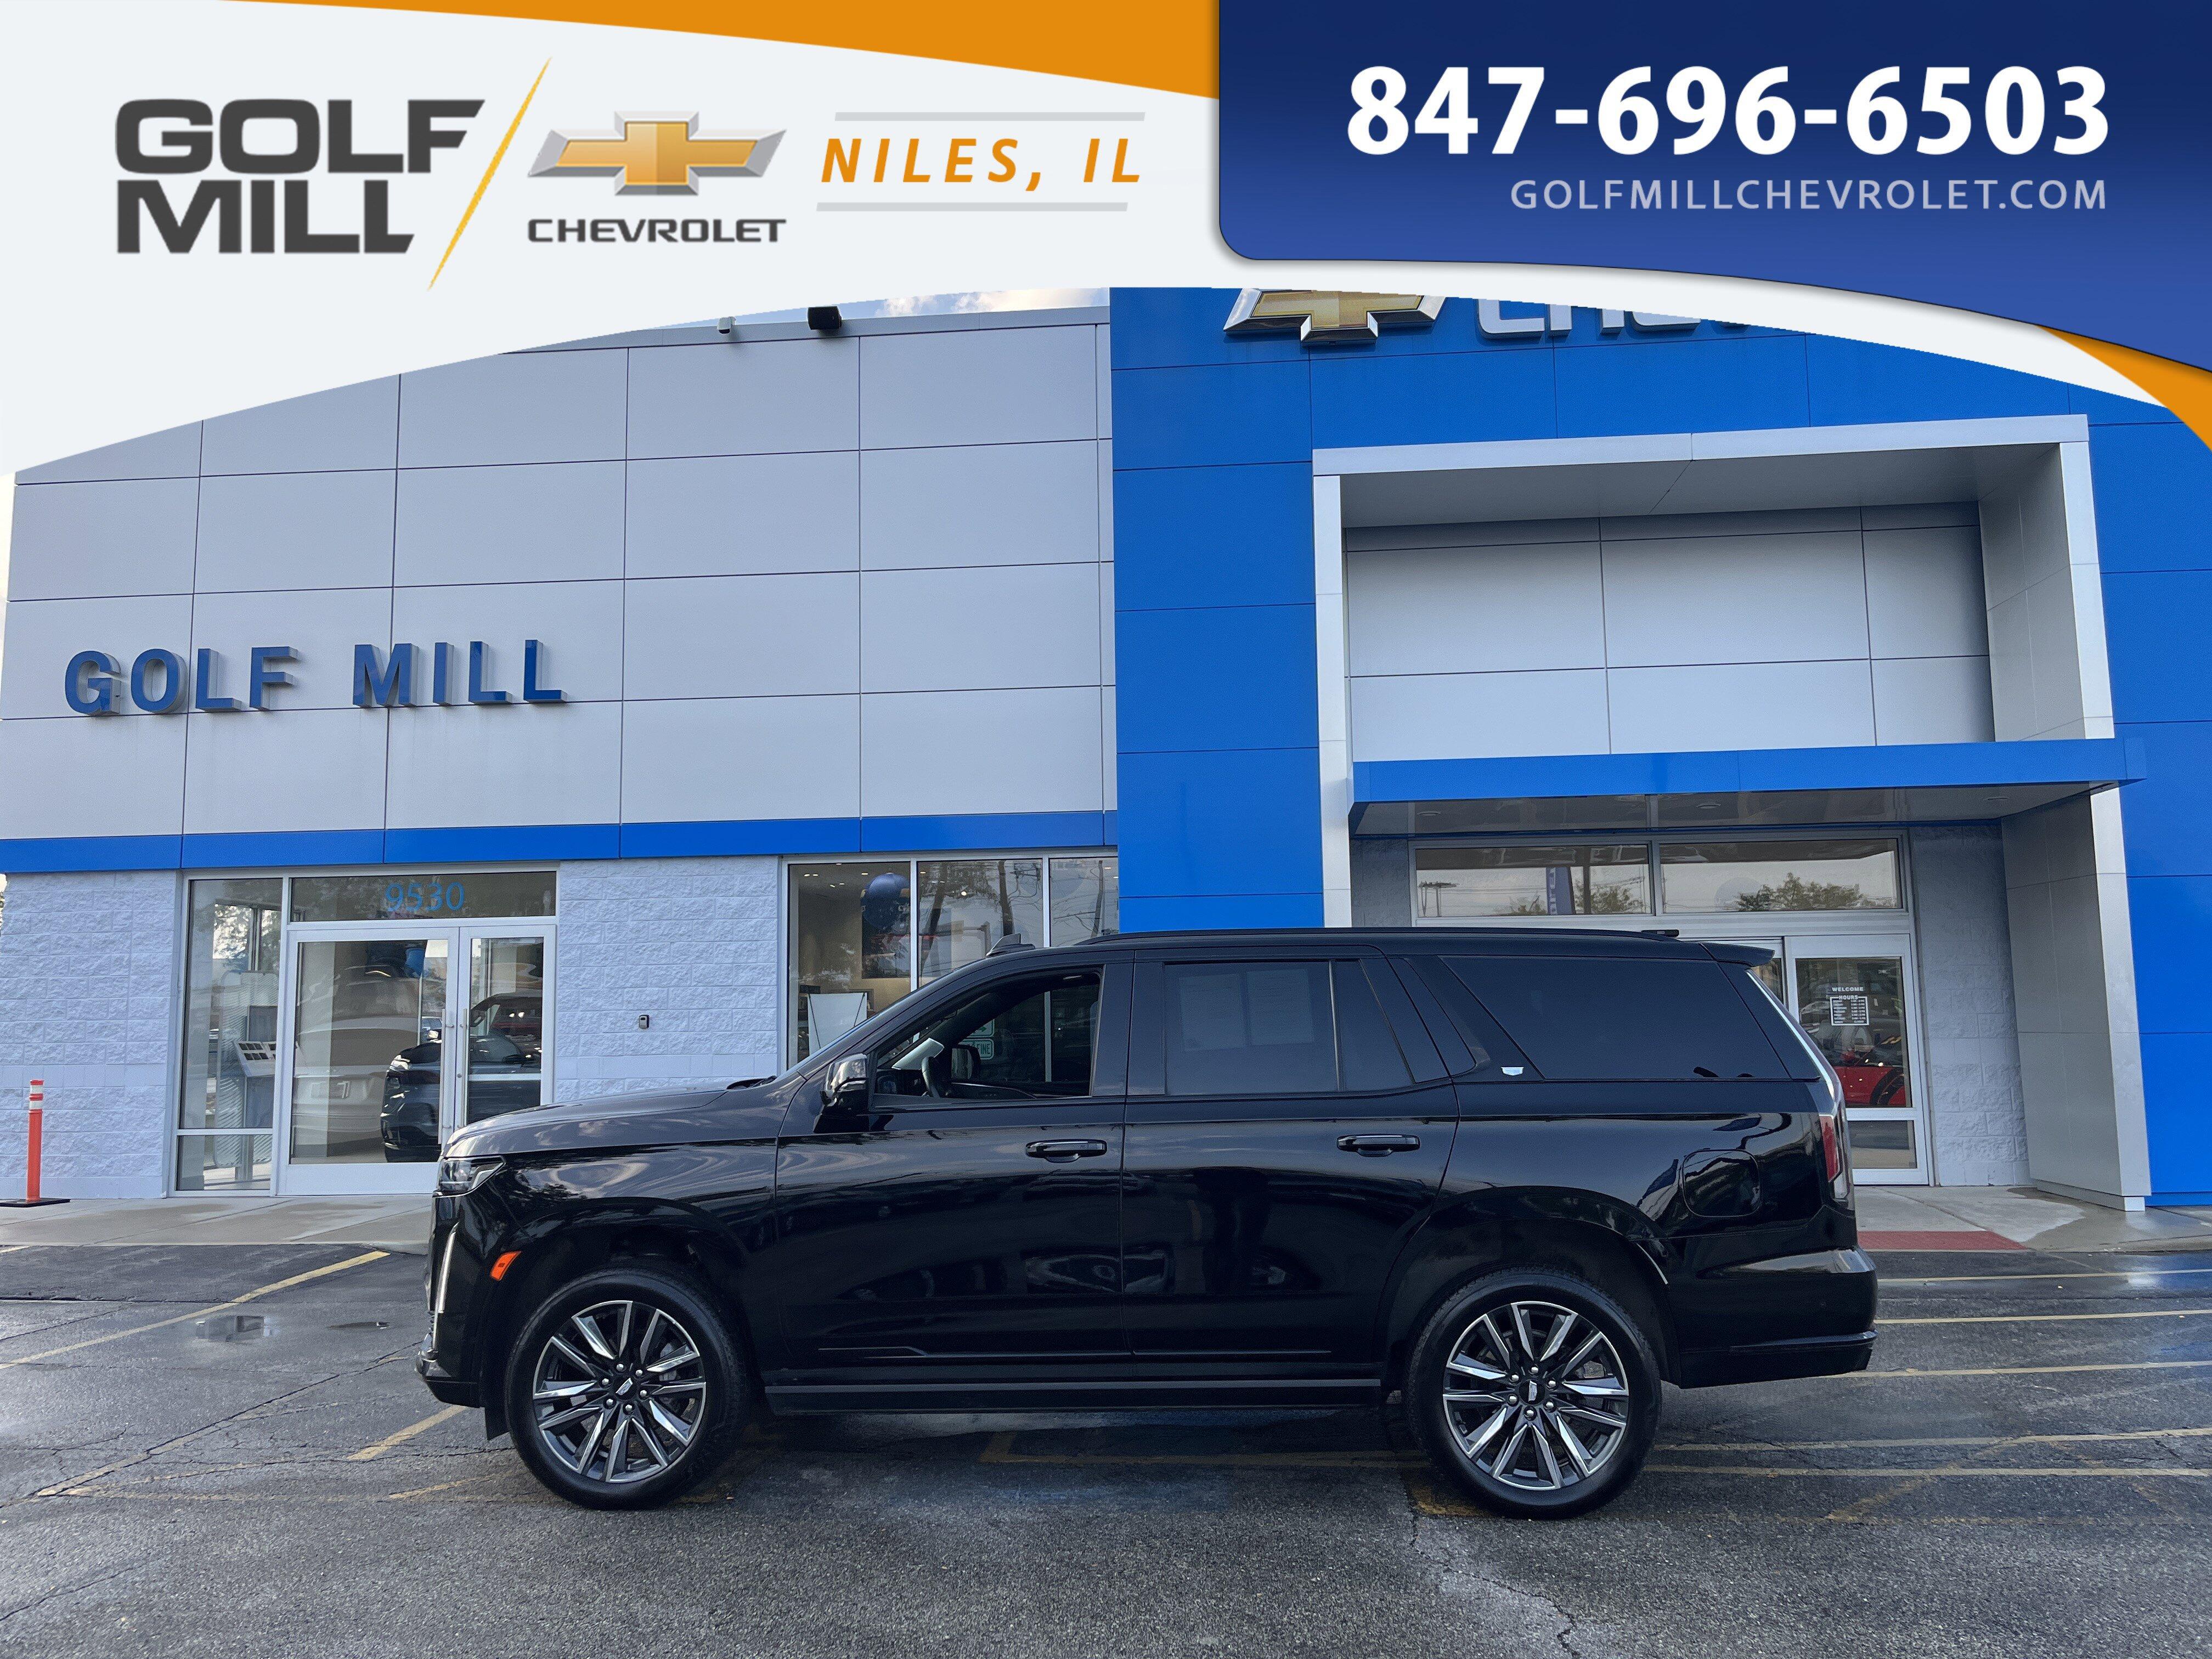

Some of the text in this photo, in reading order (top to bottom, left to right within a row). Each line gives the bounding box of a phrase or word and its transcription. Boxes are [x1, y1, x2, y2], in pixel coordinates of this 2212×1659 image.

[65, 639, 567, 716] GOLF MILL
[385, 882, 465, 912] 9530
